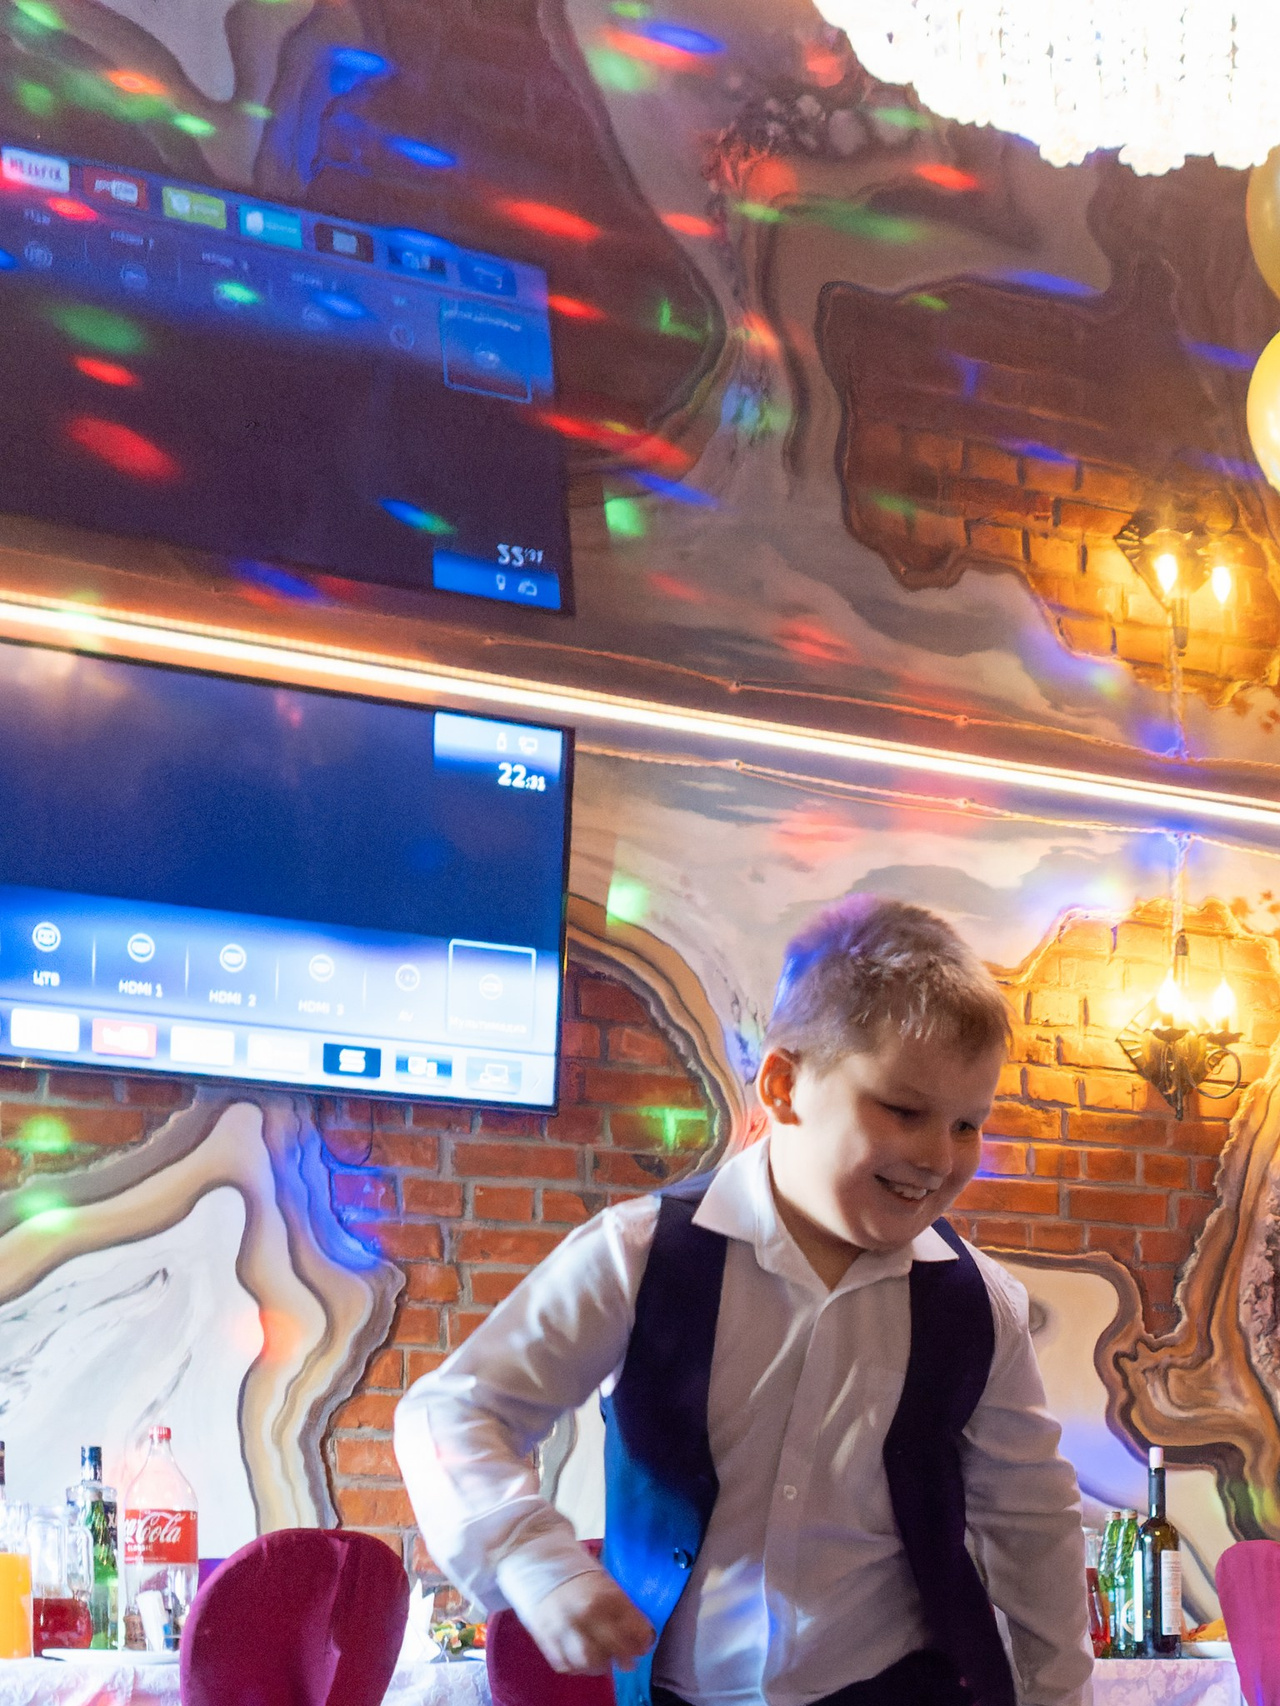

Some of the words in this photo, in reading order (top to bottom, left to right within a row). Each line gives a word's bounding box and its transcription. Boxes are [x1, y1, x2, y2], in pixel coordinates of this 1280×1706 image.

[119, 979, 152, 996] HDMI
[209, 989, 242, 1006] HDMI
[248, 994, 257, 1007] 2
[298, 999, 330, 1014] HDMI
